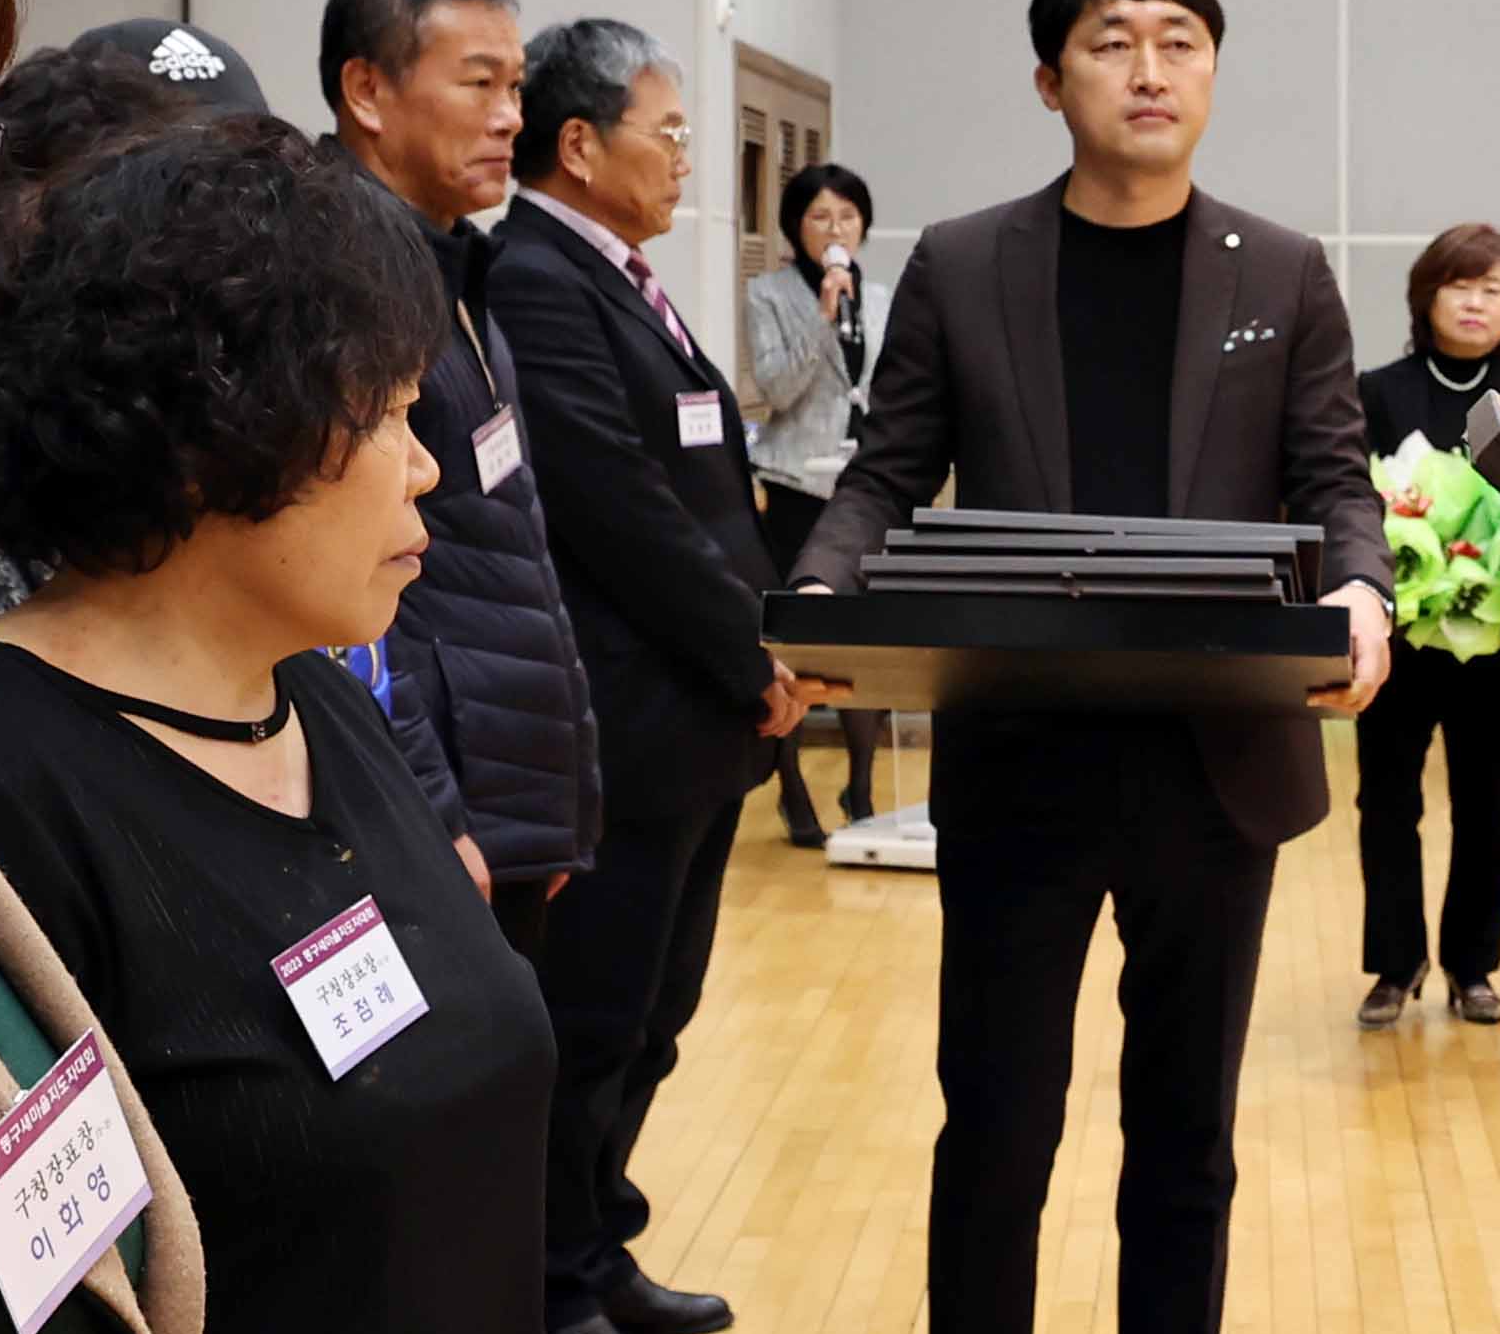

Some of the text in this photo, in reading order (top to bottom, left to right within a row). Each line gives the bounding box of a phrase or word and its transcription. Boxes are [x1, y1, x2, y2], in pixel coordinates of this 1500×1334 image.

[149, 53, 226, 74] adidas
[168, 67, 218, 81] GOLF
[0, 1046, 96, 1155] 동구새마을지도자대회
[14, 1120, 95, 1219] 구청장표창
